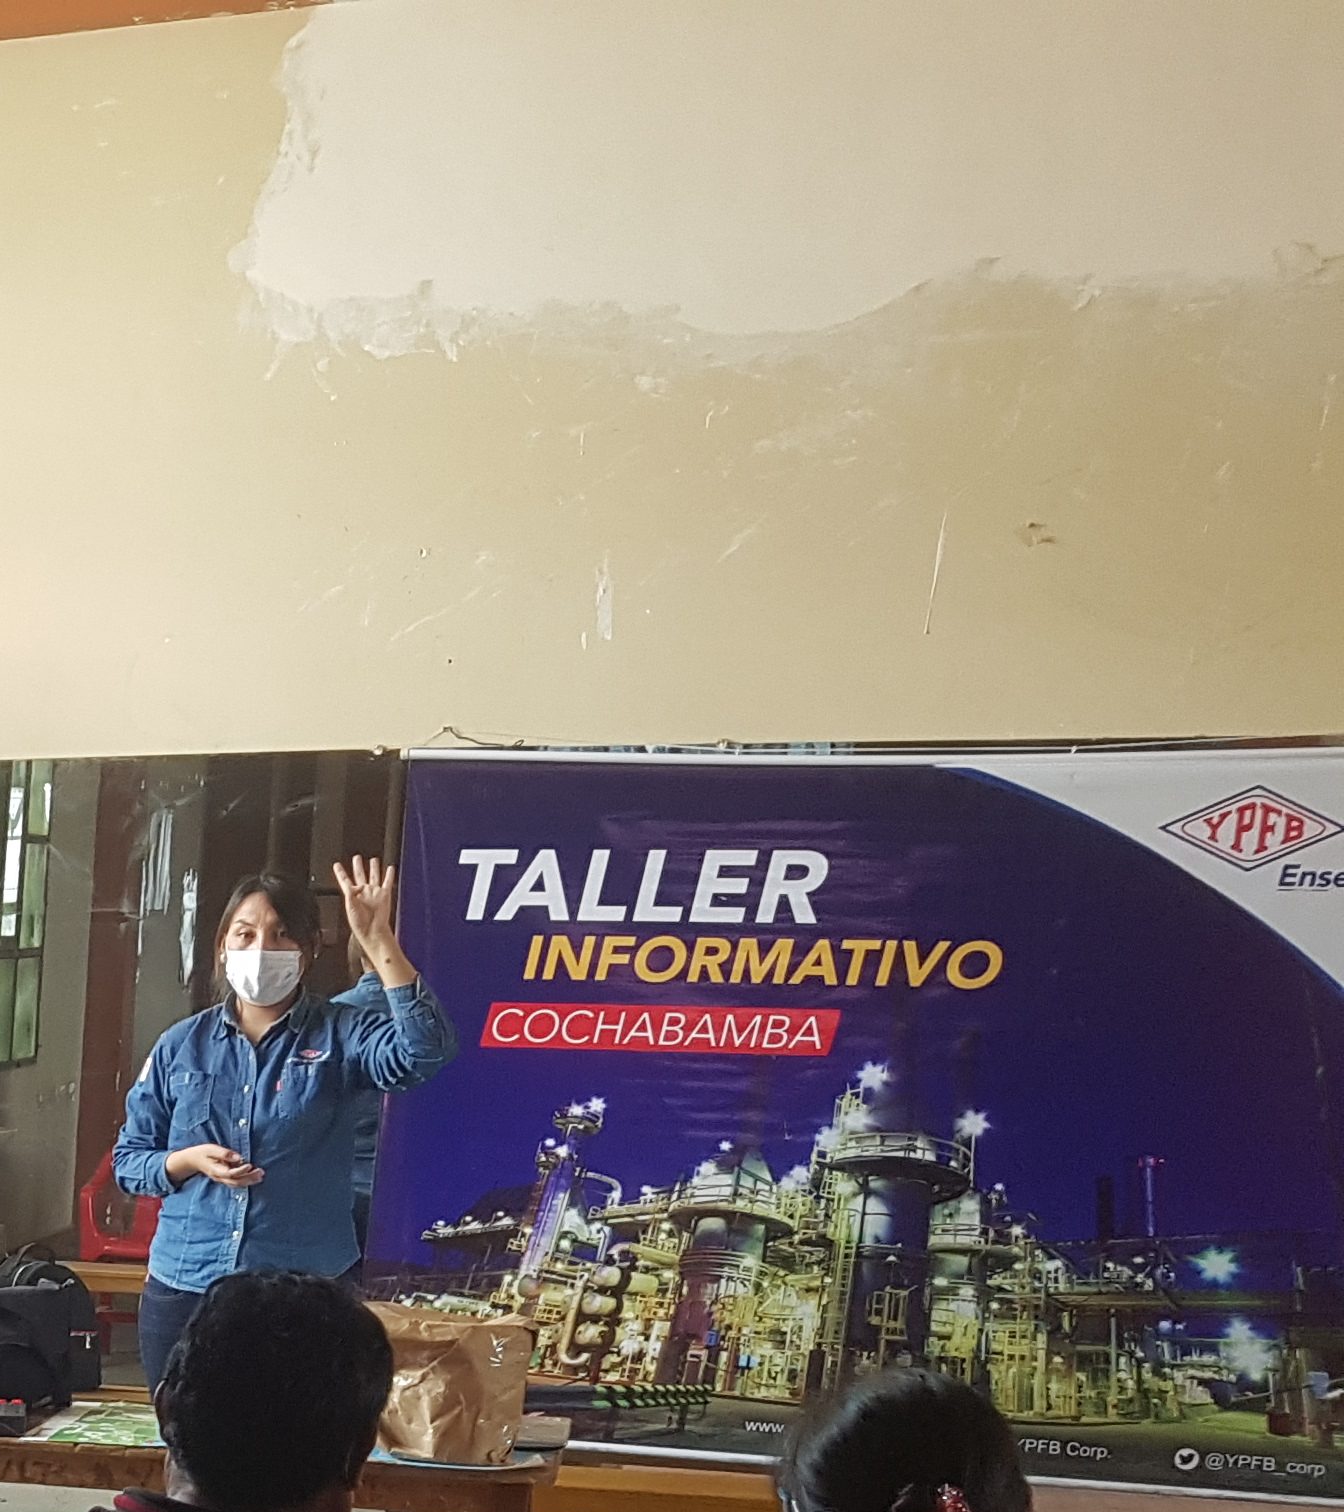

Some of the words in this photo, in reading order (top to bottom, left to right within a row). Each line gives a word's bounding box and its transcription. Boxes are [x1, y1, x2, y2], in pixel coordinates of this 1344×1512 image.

[1203, 801, 1305, 856] YPFB
[458, 847, 829, 925] TALLER
[522, 934, 1003, 990] INFORMATIVO
[490, 1007, 824, 1051] COCHABAMBA
[1066, 1441, 1112, 1461] Corp.
[1204, 1453, 1326, 1478] @YPFB_corp
